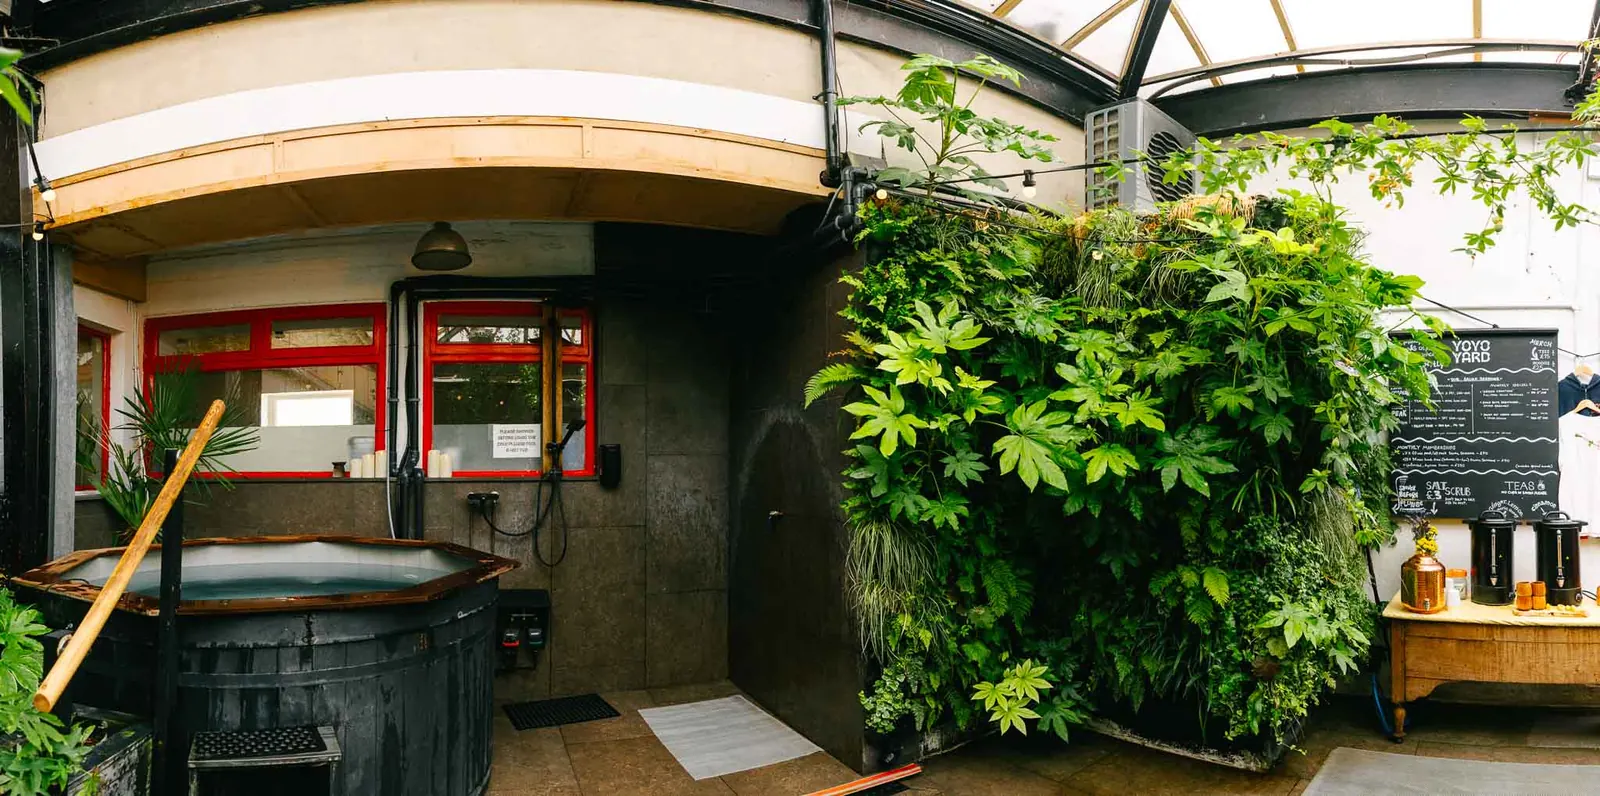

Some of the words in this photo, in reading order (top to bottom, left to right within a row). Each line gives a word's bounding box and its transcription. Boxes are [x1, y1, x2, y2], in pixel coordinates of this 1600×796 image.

[1451, 340, 1491, 352] YOYO
[1529, 338, 1552, 348] MERCH
[1451, 351, 1491, 364] YARD
[1391, 409, 1407, 417] PEAK
[1425, 481, 1448, 491] SALT
[1444, 486, 1472, 496] SCRUB
[1504, 481, 1535, 491] TEAS
[1425, 490, 1442, 500] £3
